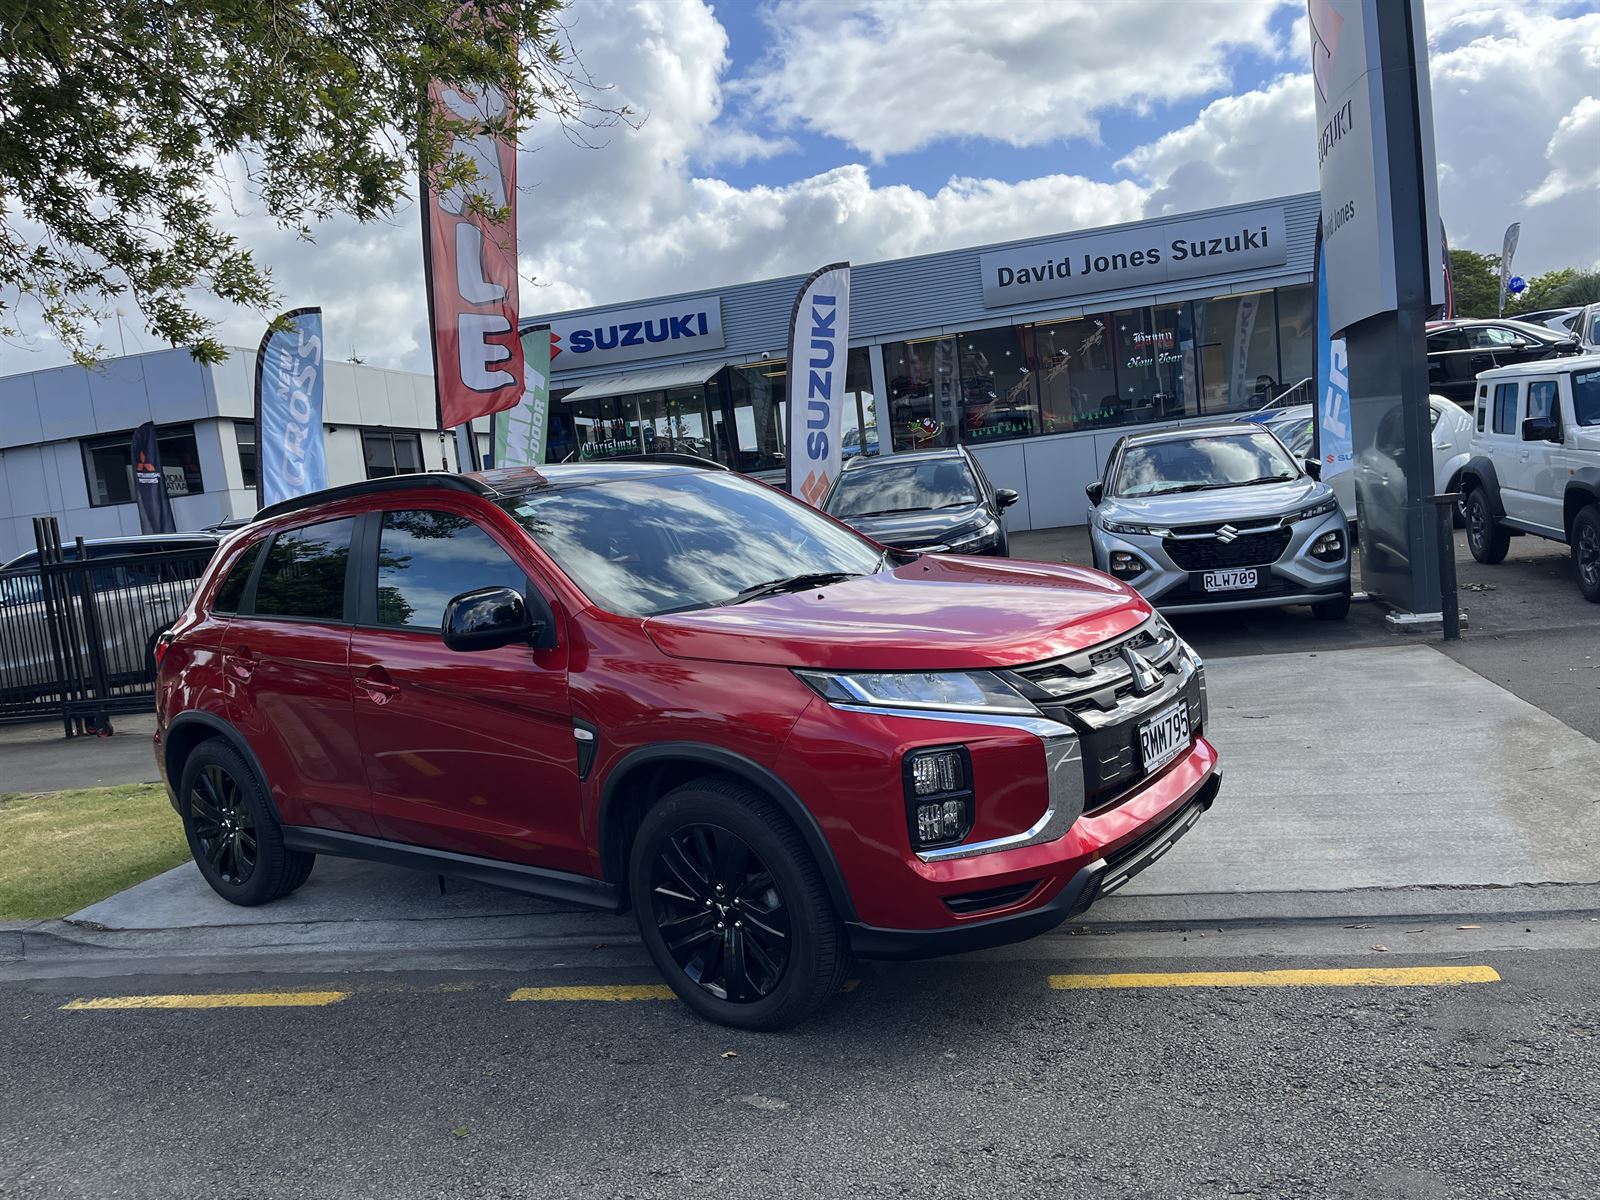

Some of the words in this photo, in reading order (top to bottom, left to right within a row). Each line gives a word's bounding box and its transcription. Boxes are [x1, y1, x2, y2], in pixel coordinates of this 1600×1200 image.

[1334, 200, 1354, 232] Jones
[997, 257, 1071, 288] David
[1081, 248, 1160, 275] Jones
[1171, 226, 1269, 261] Suzuki
[569, 312, 708, 353] SUZUKI
[277, 348, 293, 401] NEW
[807, 295, 836, 461] SUZUKI
[1127, 356, 1153, 368] New
[1159, 352, 1182, 364] Year
[582, 438, 637, 458] Christmas
[1205, 572, 1256, 588] RLW709
[1141, 708, 1188, 763] RMM795
